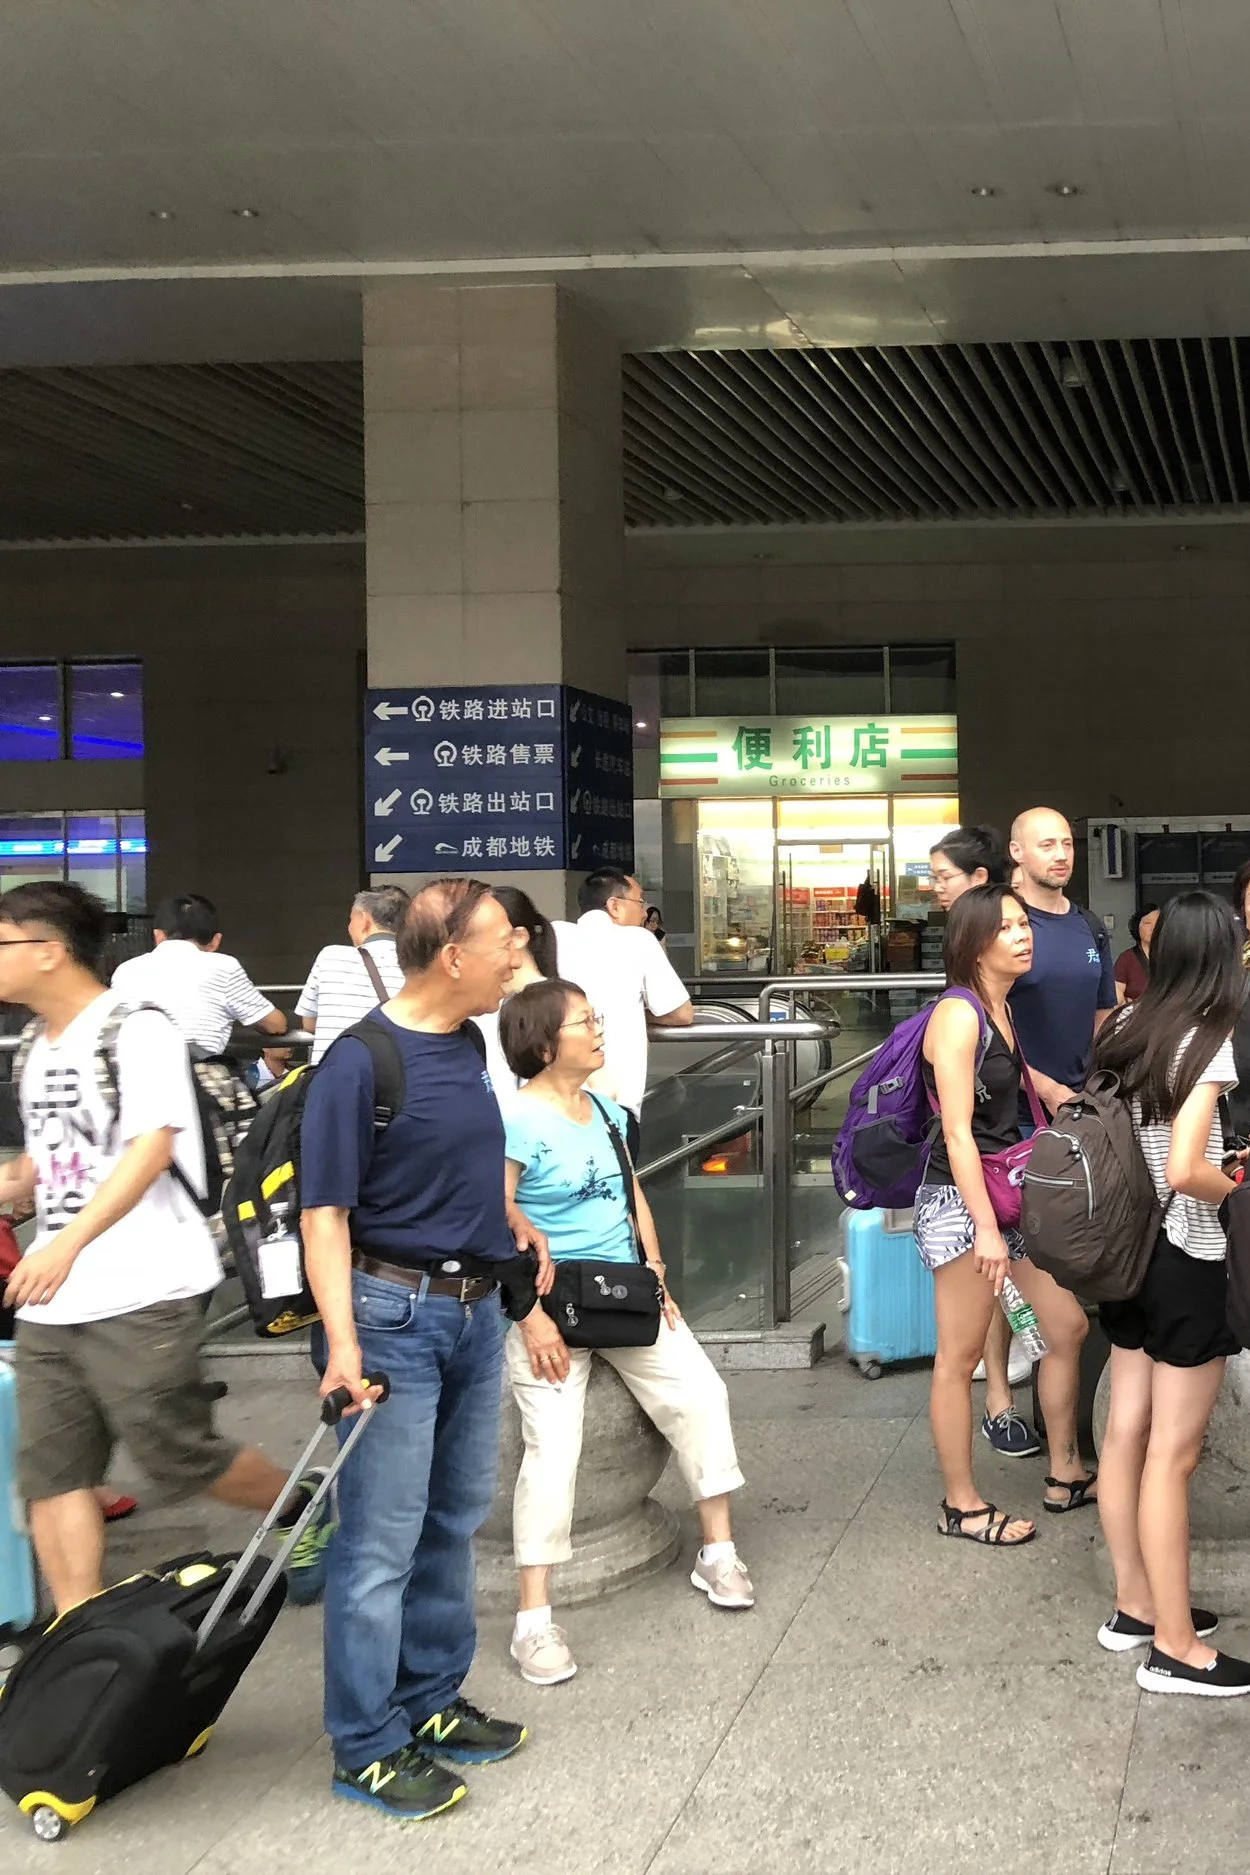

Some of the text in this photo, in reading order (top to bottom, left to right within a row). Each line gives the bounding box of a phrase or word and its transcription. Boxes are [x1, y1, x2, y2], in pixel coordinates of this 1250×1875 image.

[439, 697, 556, 721] 铁路进站口
[461, 743, 555, 766] 铁路售票
[731, 722, 890, 771] 便利店
[768, 774, 852, 787] Groceries
[437, 791, 555, 815] 铁路出站口
[461, 835, 556, 858] 成都地铁
